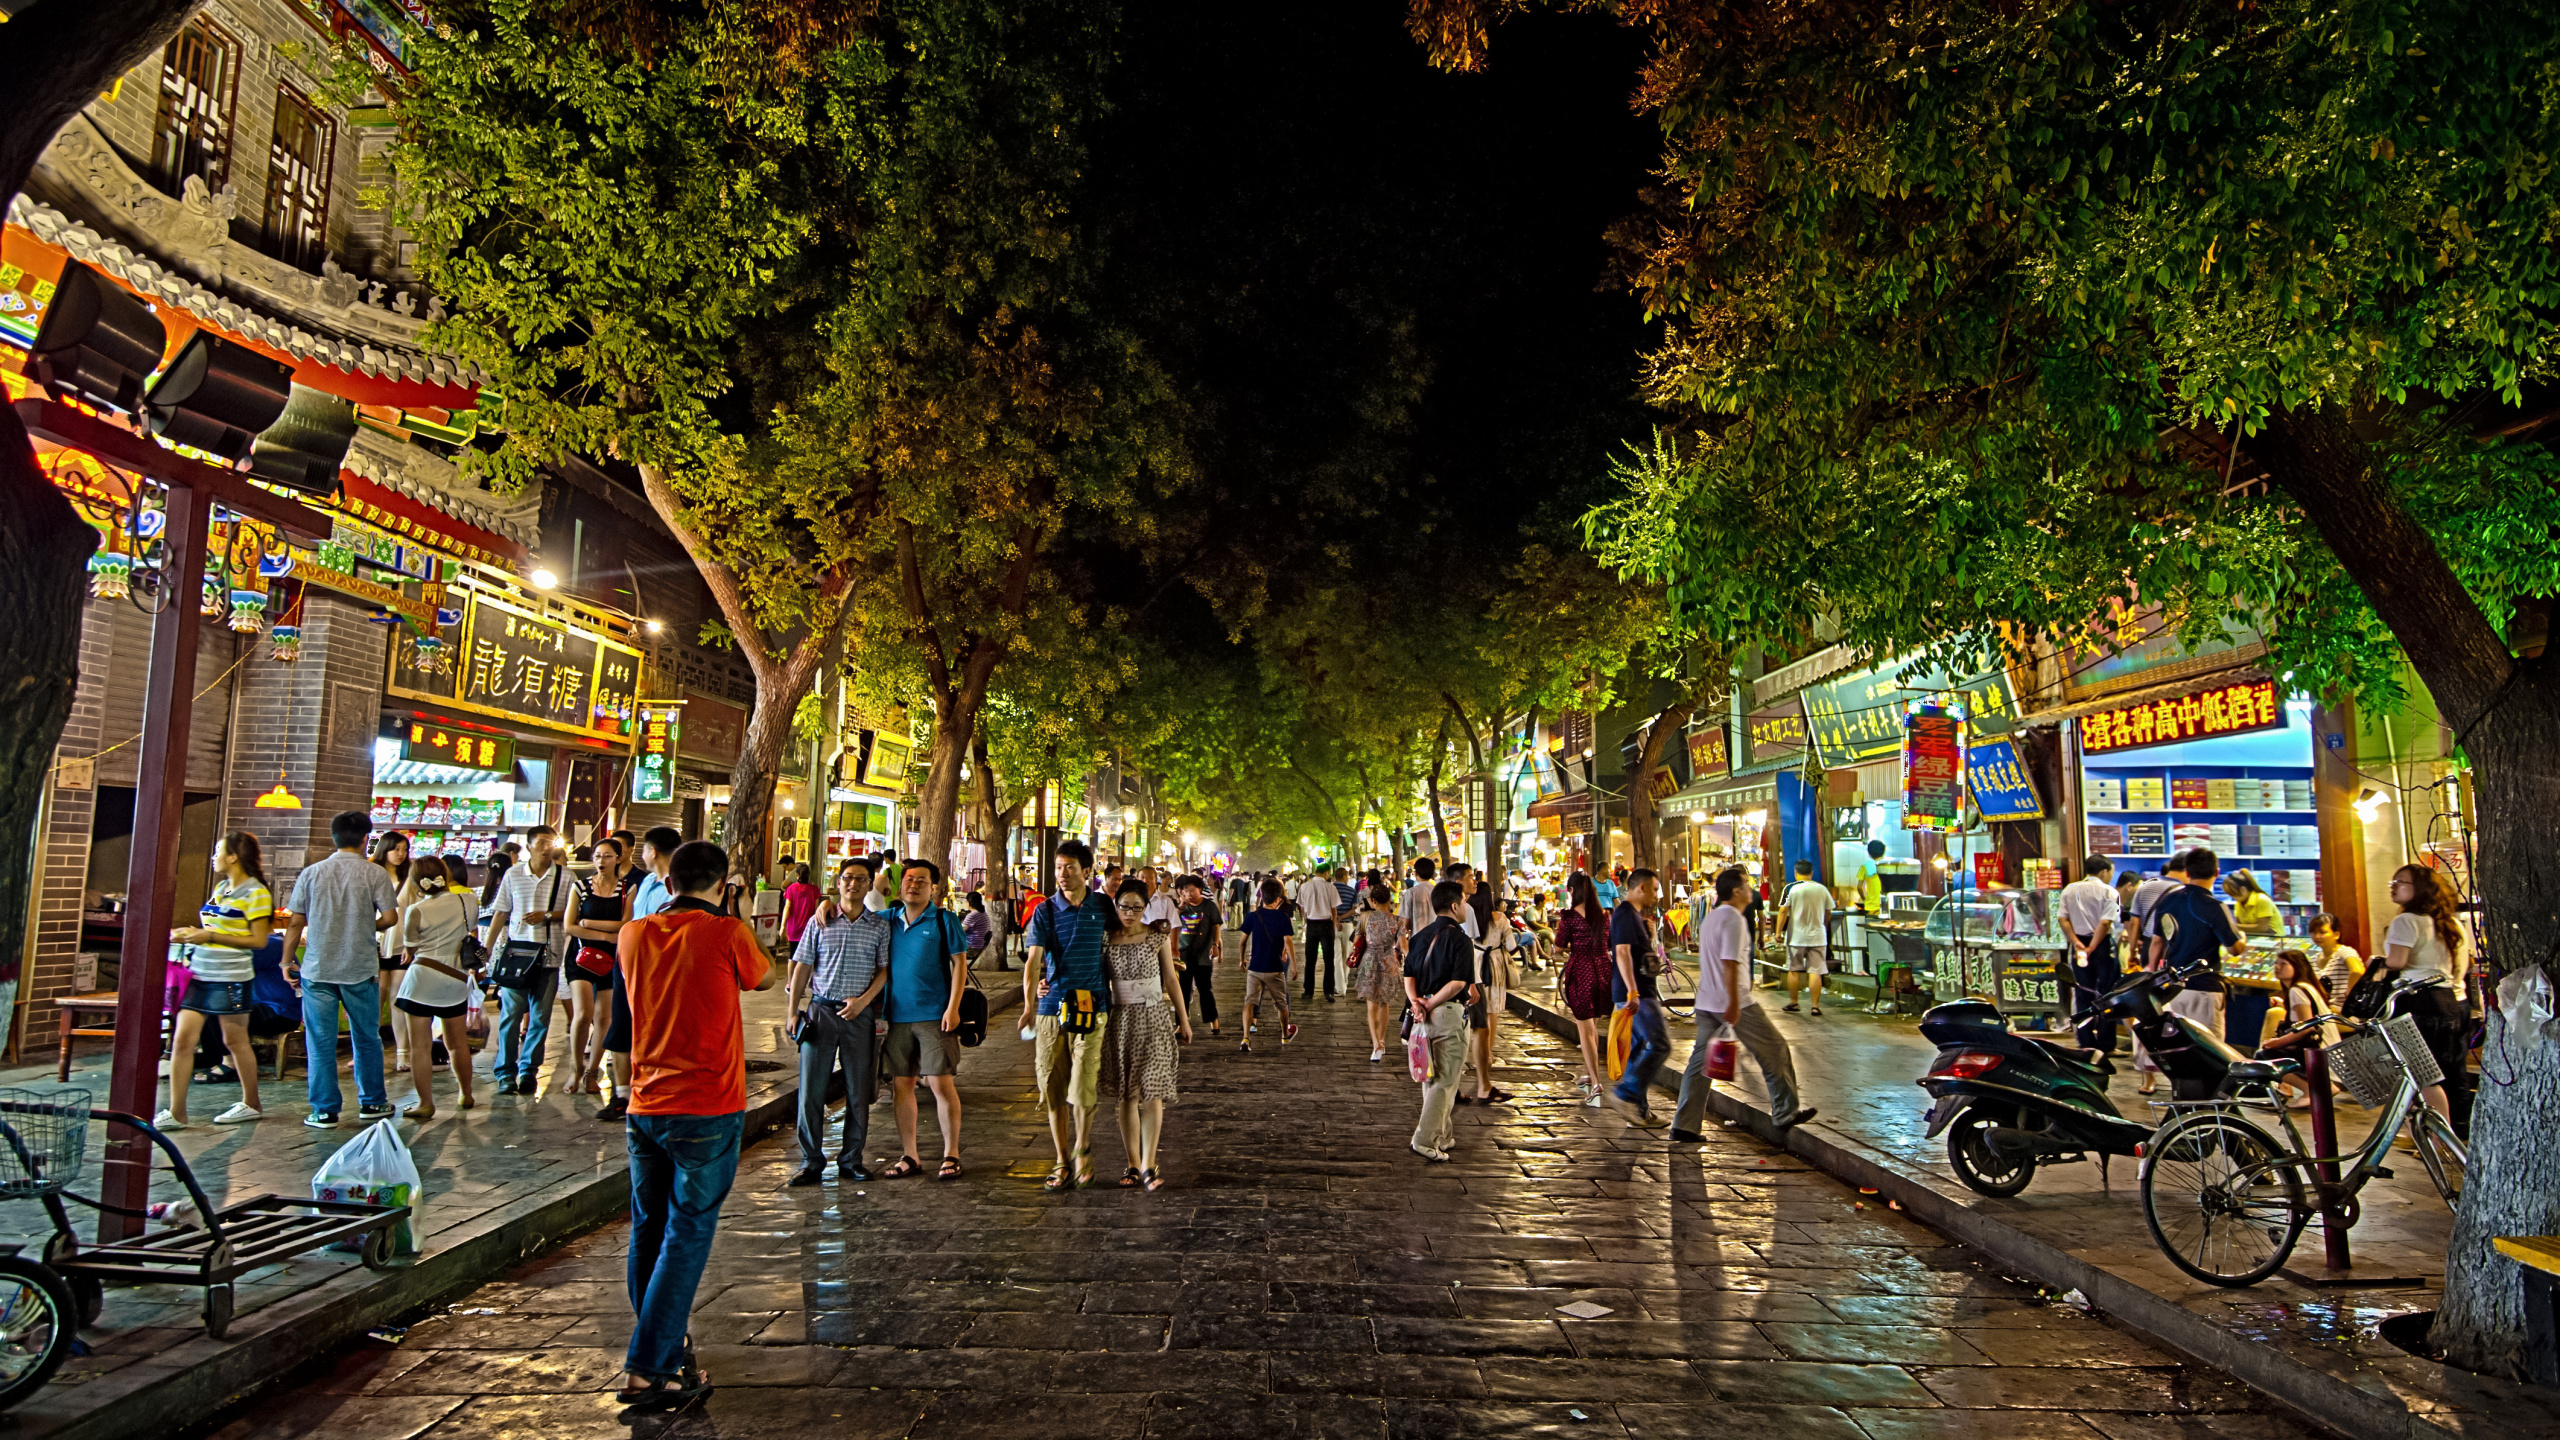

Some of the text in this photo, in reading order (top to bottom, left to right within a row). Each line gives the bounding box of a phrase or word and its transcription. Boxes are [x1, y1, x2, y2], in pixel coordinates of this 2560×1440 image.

[467, 637, 584, 713] 龍須糖
[1753, 713, 1802, 748] 红太阳工艺
[1914, 716, 1953, 816] 军军绿豆糕
